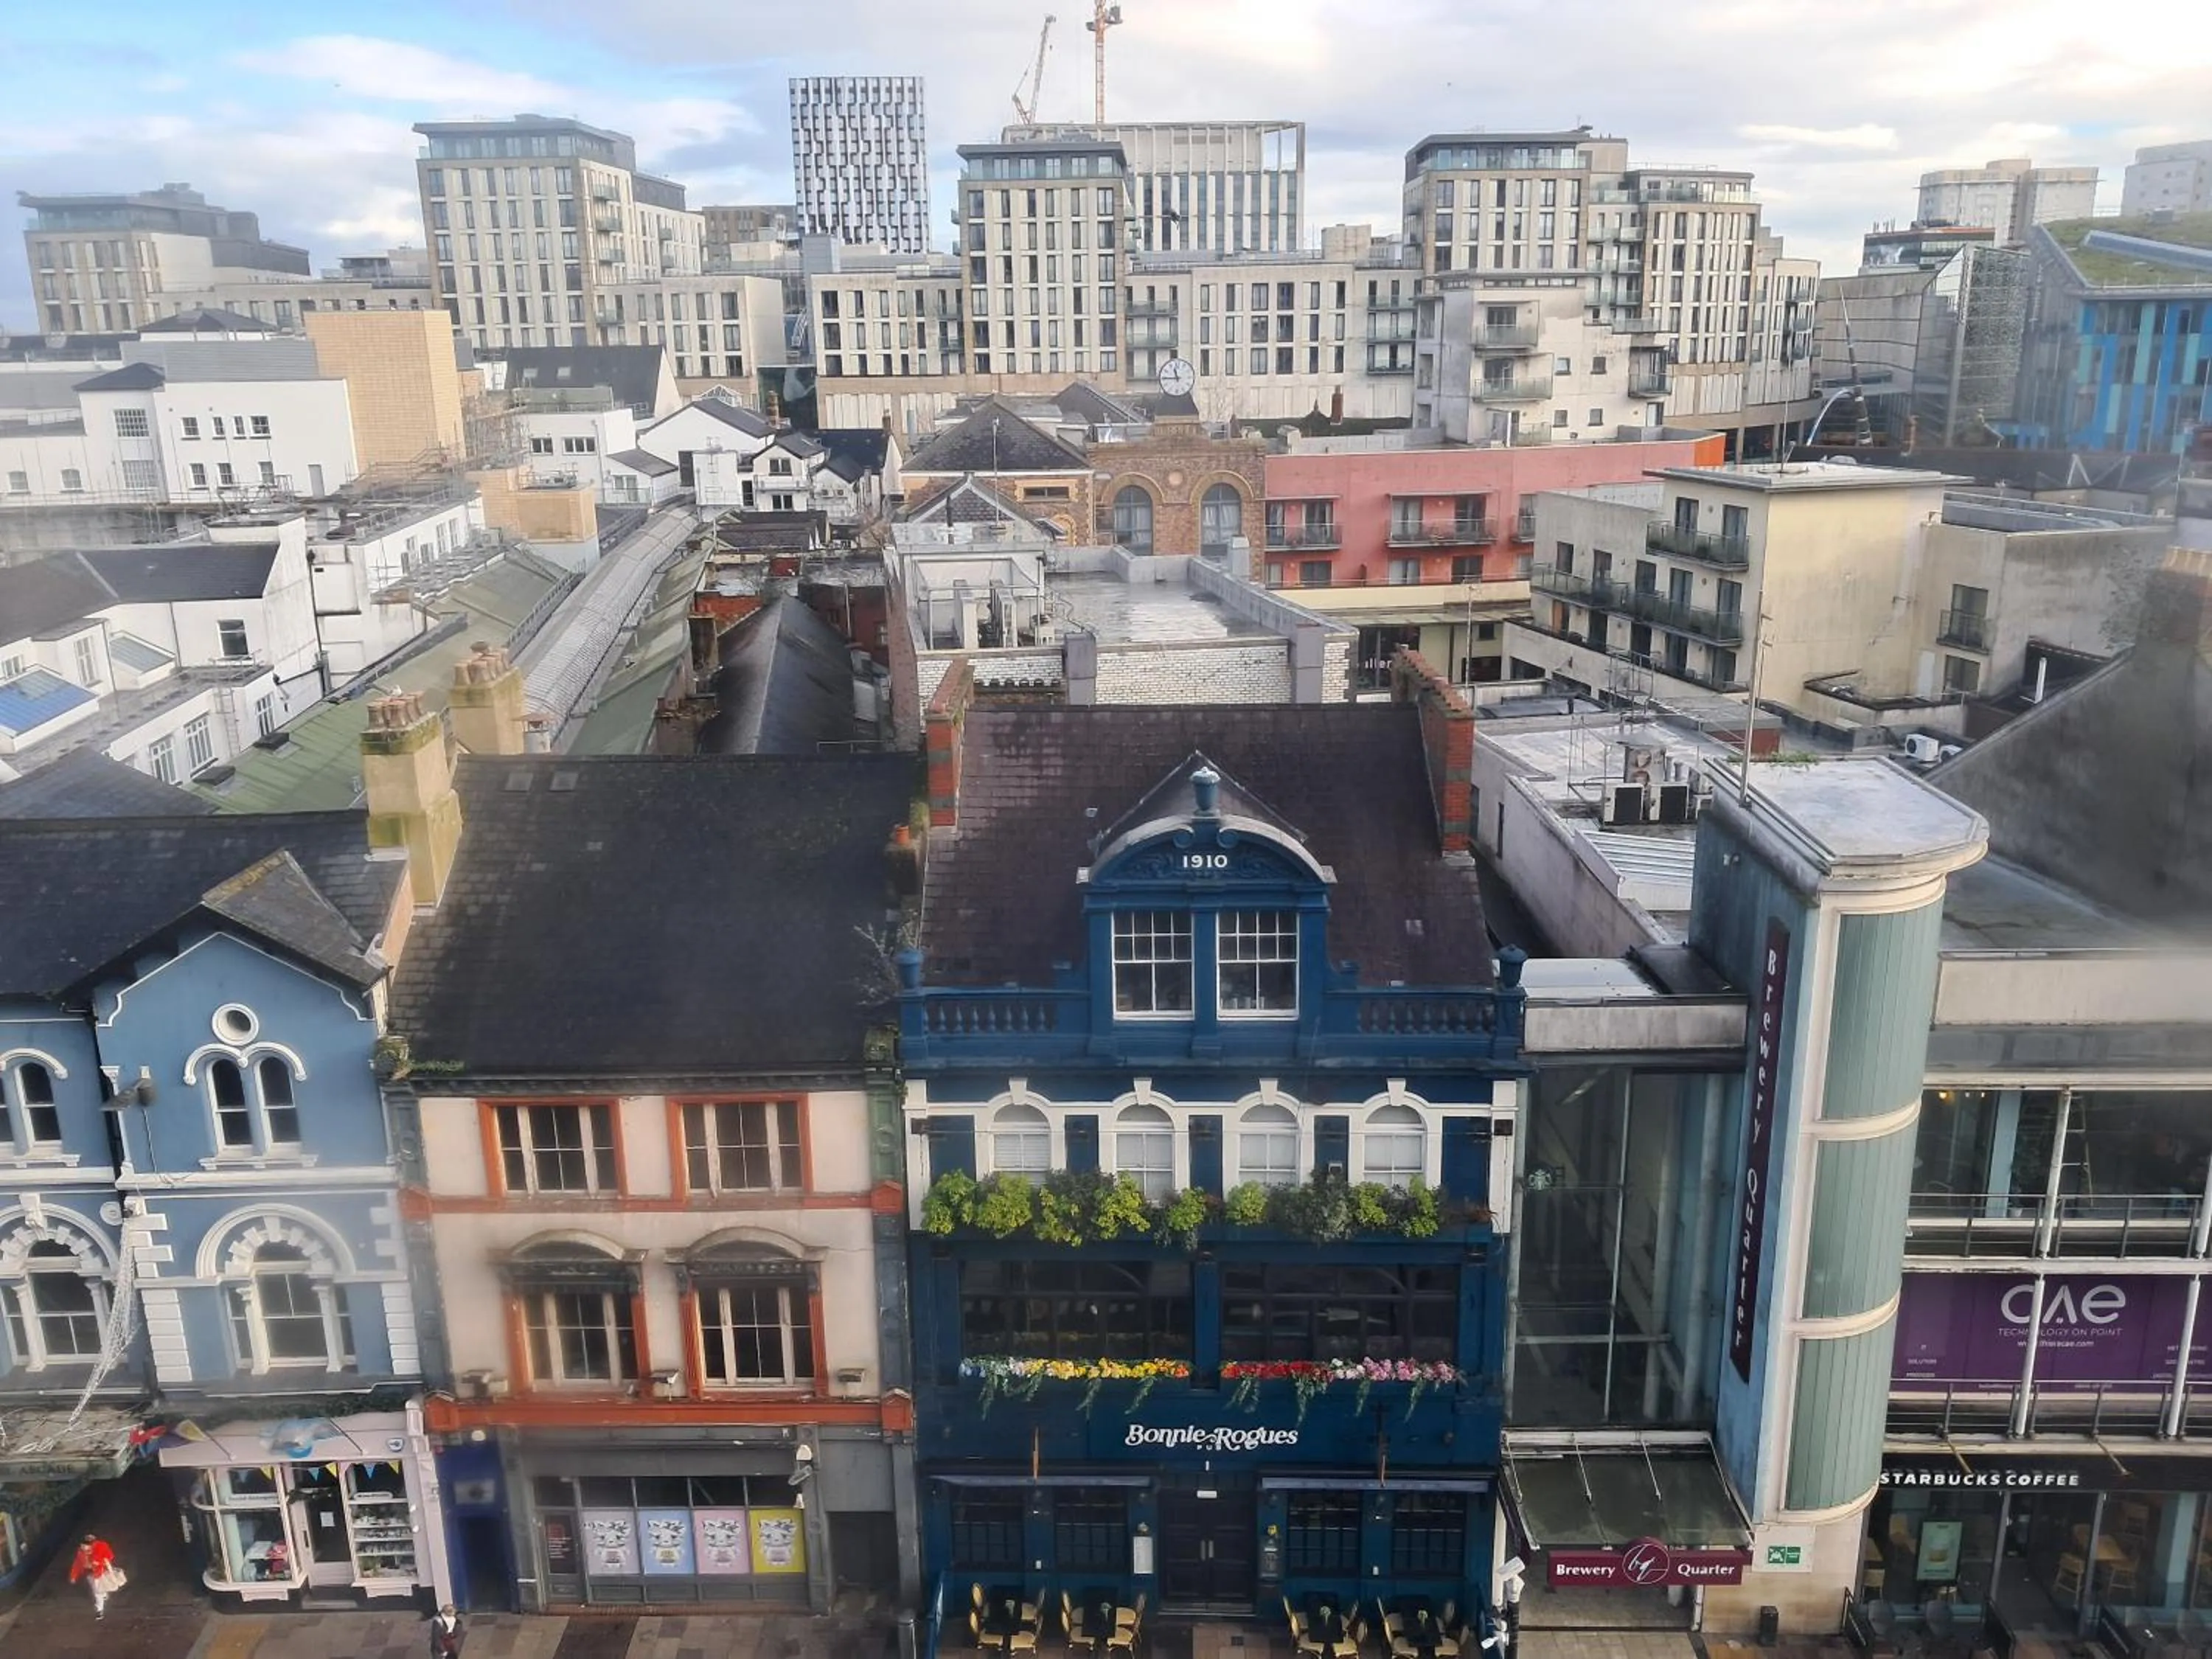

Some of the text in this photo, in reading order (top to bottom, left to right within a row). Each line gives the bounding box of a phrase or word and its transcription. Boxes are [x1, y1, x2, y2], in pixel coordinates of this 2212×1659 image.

[1183, 855, 1228, 868] 1910
[1736, 948, 1776, 1346] Brewery Quarter
[1998, 1328, 2124, 1337] TECHNLOGY ON POINT
[1125, 1424, 1298, 1451] Bonnie Rogues
[1879, 1472, 2080, 1486] STARBUCKS COFFEE
[1556, 1564, 1615, 1578] Brewery
[1677, 1564, 1735, 1576] Quarter
